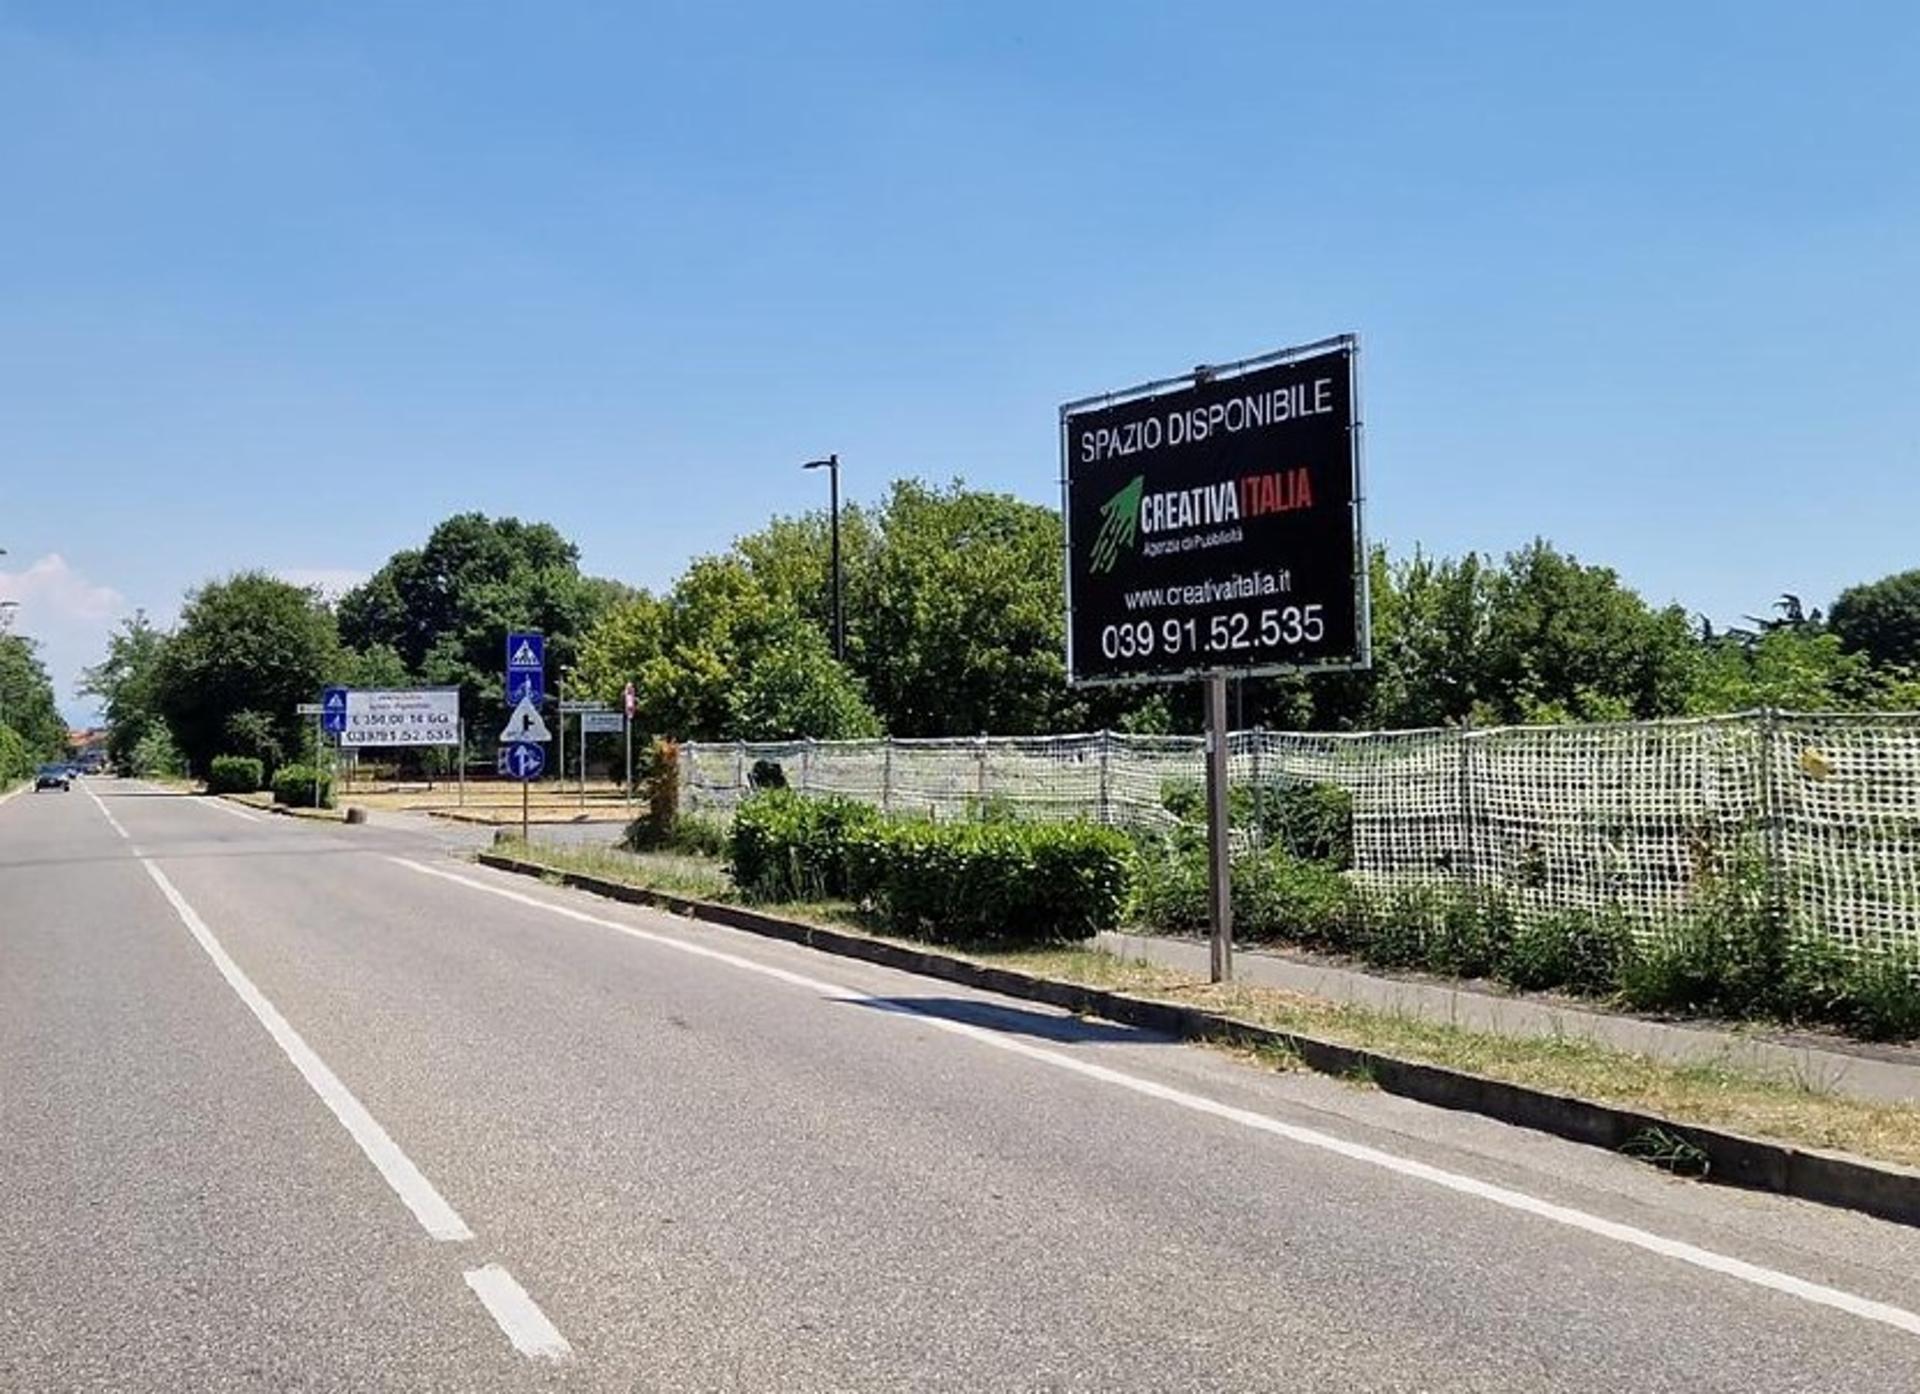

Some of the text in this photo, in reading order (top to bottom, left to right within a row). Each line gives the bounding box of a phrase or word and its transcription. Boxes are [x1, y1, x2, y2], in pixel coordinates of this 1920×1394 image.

[1081, 378, 1333, 462] SPAZIO DISPONIBILE
[1124, 568, 1291, 611] www.creativaitalia.it
[1102, 604, 1324, 659] 039 91.52.535
